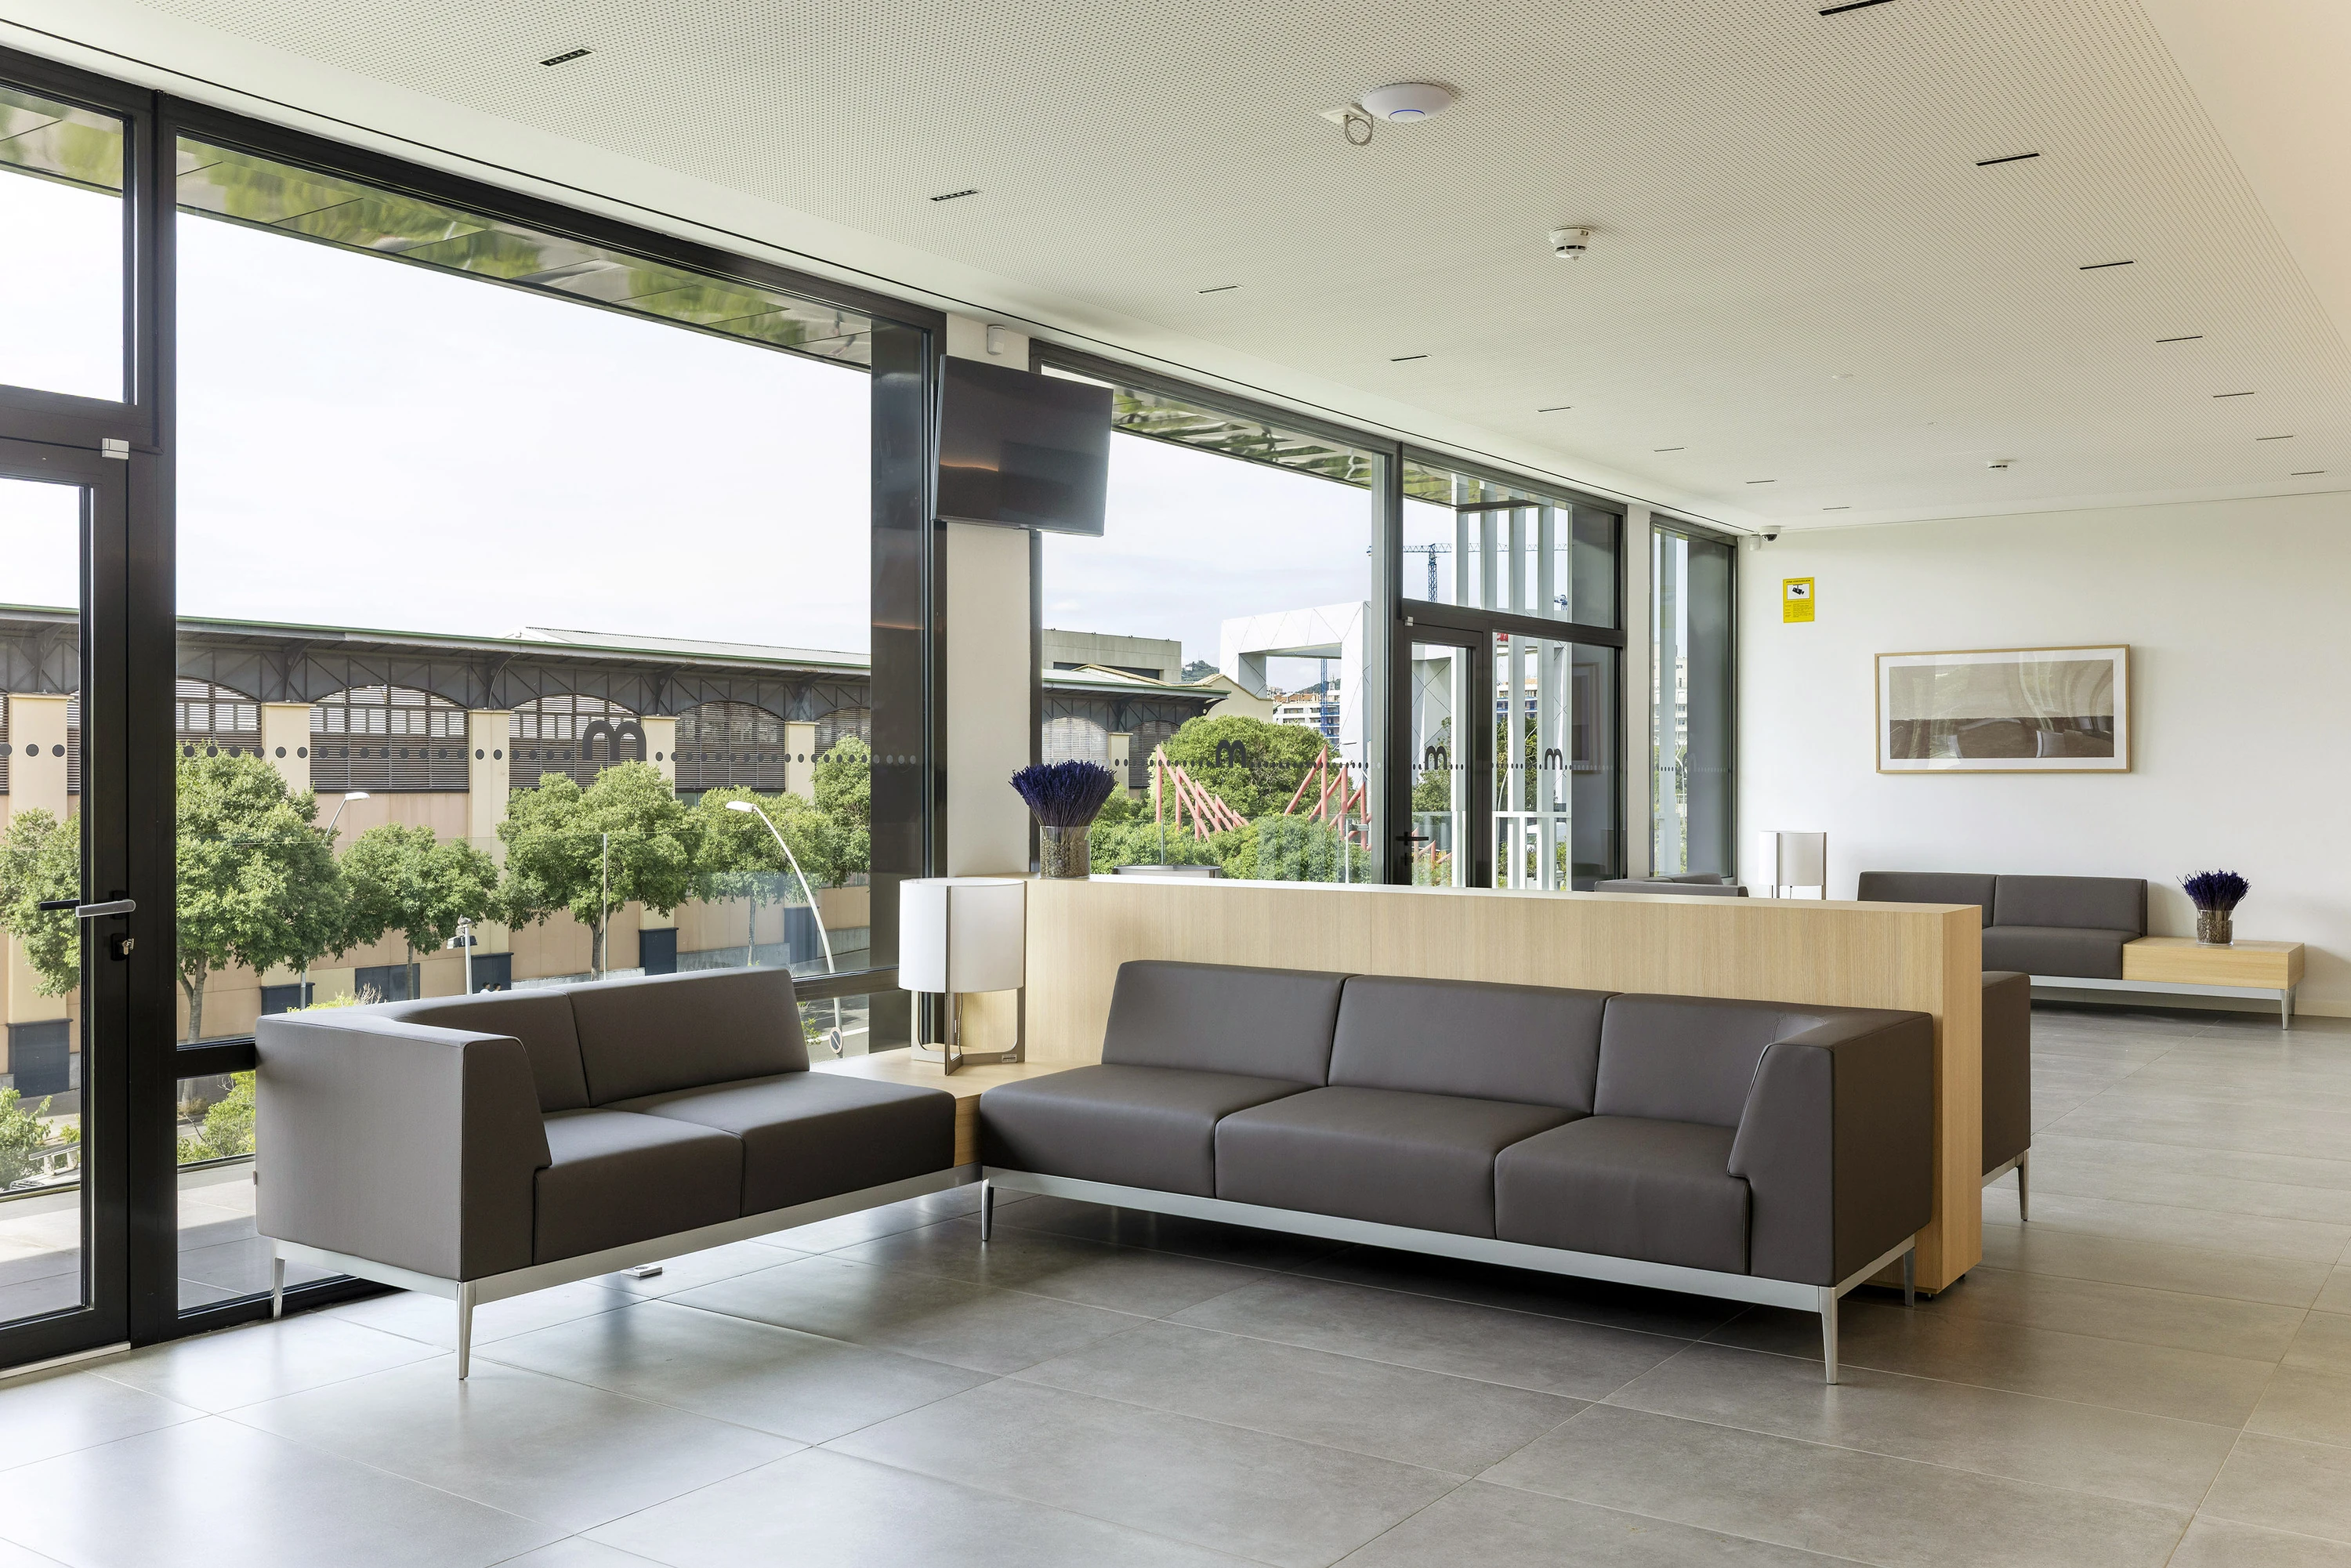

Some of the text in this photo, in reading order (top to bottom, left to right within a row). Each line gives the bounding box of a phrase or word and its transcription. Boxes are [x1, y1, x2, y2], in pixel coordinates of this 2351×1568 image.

[581, 719, 647, 761] m
[1215, 739, 1246, 768] m
[1425, 745, 1447, 770] m
[1544, 748, 1563, 770] m
